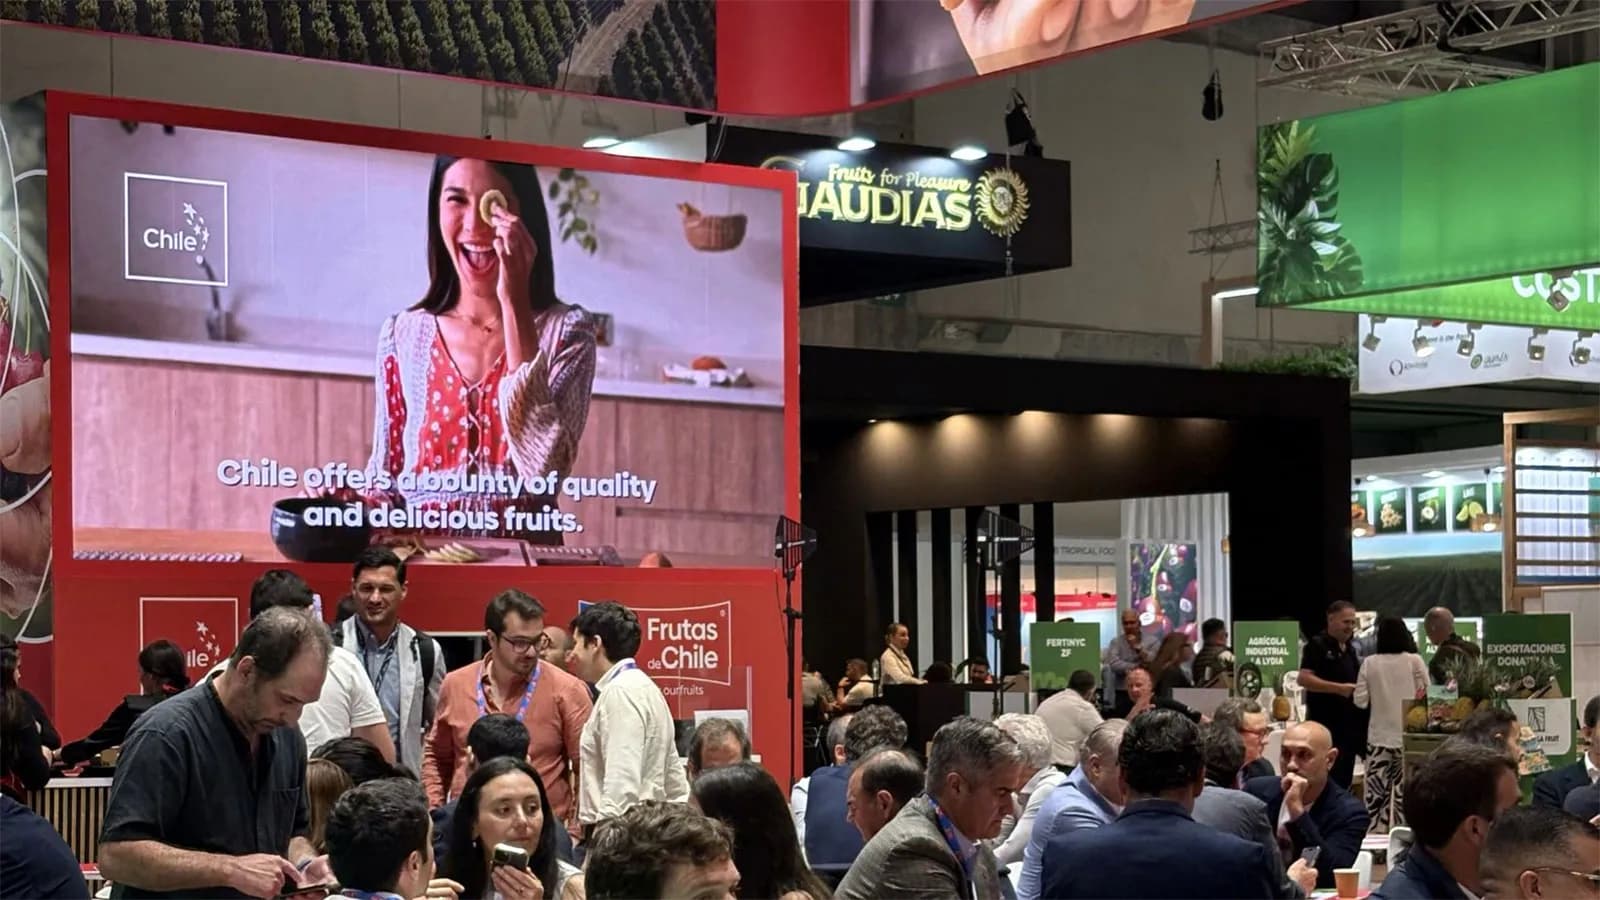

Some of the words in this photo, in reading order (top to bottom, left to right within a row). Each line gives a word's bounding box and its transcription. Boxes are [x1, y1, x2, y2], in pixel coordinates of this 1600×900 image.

[828, 163, 876, 183] Fruits
[879, 167, 902, 187] for
[905, 171, 972, 192] Pleasure
[798, 181, 973, 232] AUDIAS
[143, 228, 198, 252] Chile
[1511, 267, 1600, 304] COST
[216, 459, 299, 489] Chile
[303, 463, 392, 492] offers
[396, 472, 417, 493] a
[421, 470, 524, 499] bounty
[526, 470, 559, 495] of
[562, 473, 657, 504] quality
[302, 501, 364, 529] and
[368, 501, 500, 531] delicious
[503, 505, 584, 534] fruits.
[647, 617, 718, 641] Frutas
[1045, 638, 1086, 648] FERTINYC
[1245, 647, 1290, 656] INDUSTRIAL
[1487, 643, 1566, 654] EXPORTACIONES
[187, 649, 209, 668] ile
[647, 658, 661, 670] de
[661, 643, 718, 669] Chile
[1262, 656, 1284, 666] LYDIA
